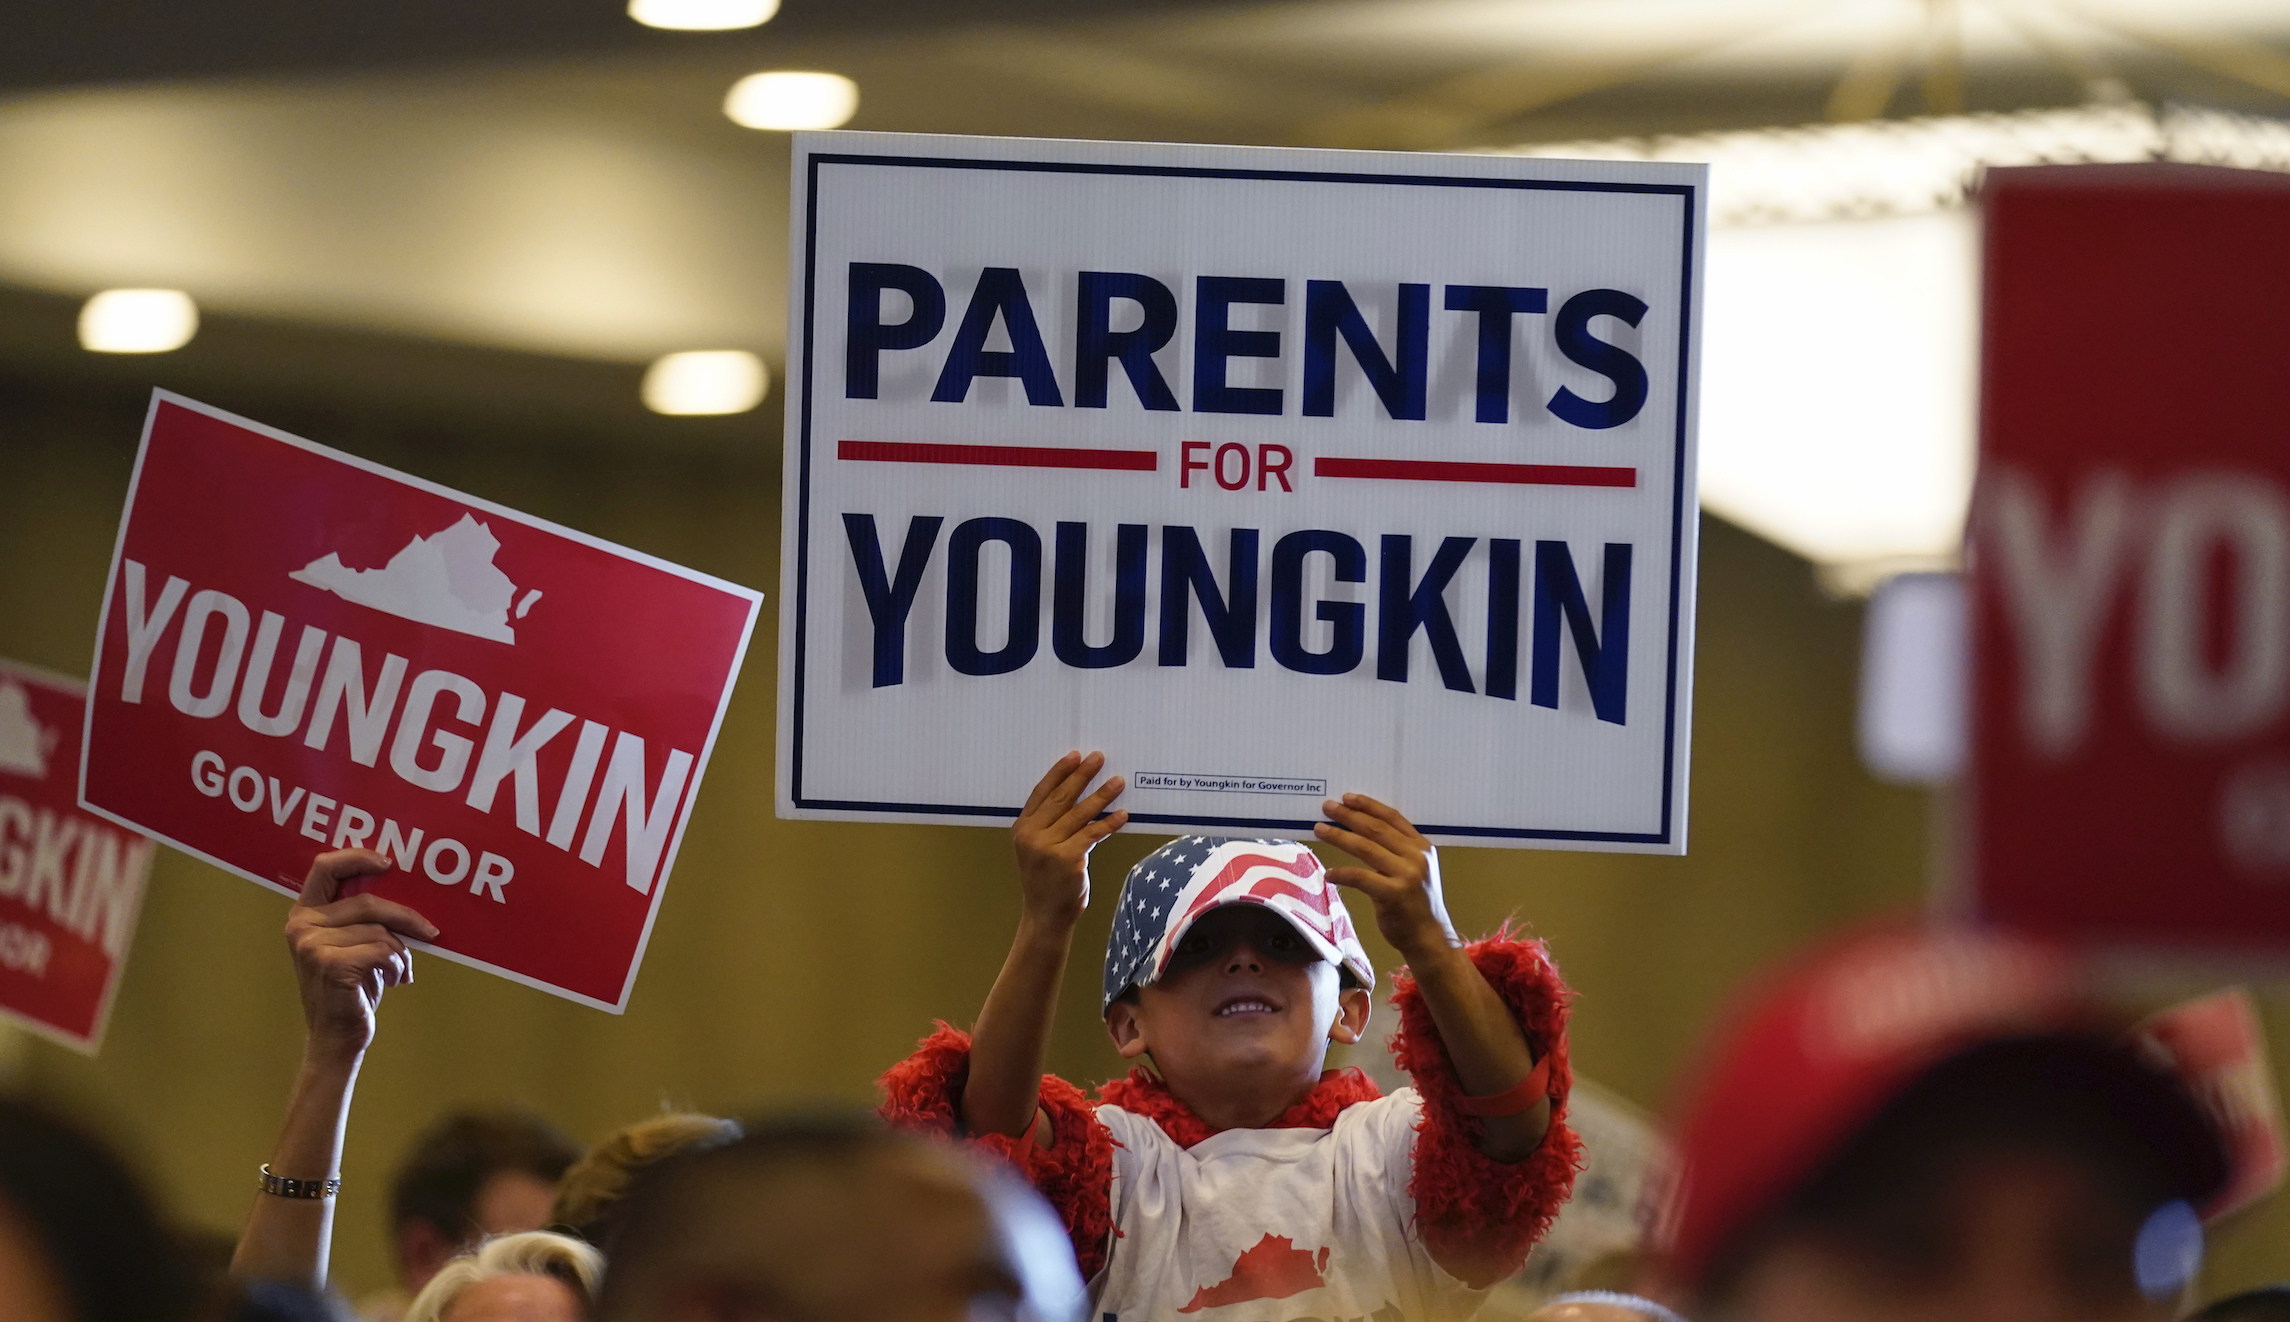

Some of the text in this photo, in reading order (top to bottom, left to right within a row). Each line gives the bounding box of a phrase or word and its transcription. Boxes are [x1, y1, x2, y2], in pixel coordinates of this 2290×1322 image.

[844, 262, 1650, 429] PARENTS
[1178, 441, 1294, 493] FOR
[841, 512, 1633, 726] YOUNGKIN
[120, 558, 694, 896] YOUNGKIN
[1140, 776, 1322, 792] Paid for by Youngkin for Governor Inc
[191, 750, 515, 904] GOVERNOR
